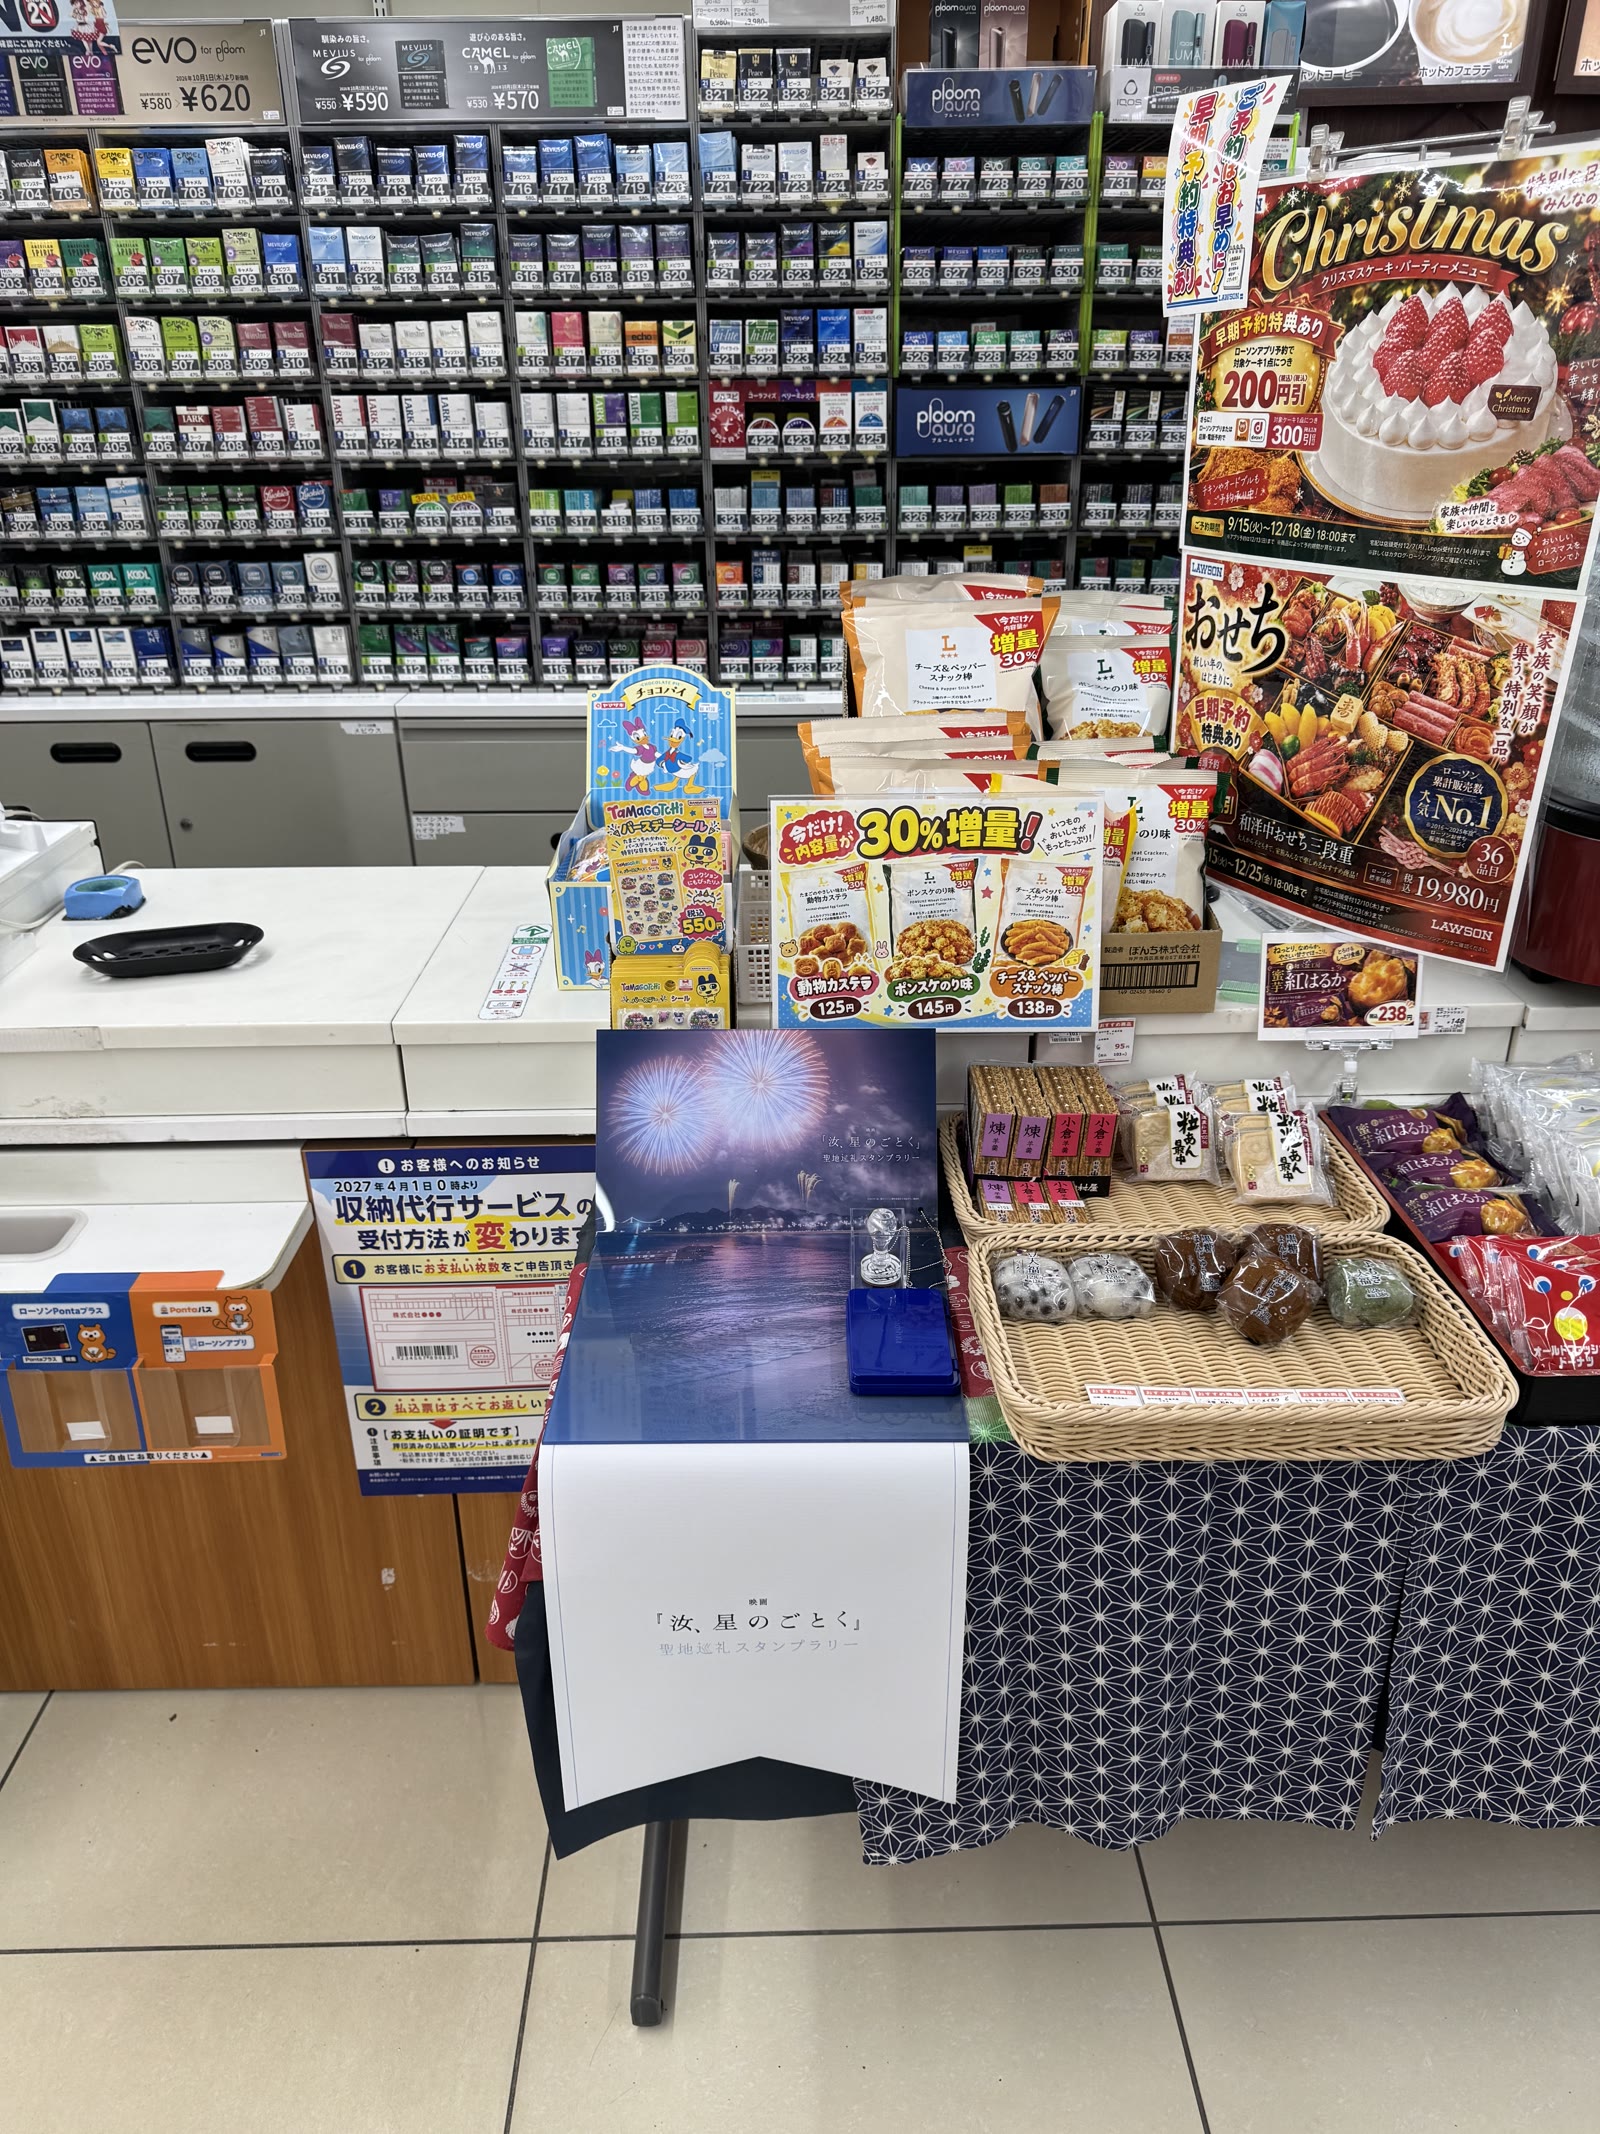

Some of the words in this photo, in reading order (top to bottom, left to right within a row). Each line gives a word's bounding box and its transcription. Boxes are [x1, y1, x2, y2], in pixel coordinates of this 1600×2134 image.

[132, 37, 197, 64] evo
[201, 46, 212, 54] for
[215, 40, 246, 62] ploom
[313, 49, 356, 58] MEVIUS
[462, 47, 511, 59] CAMEL
[20, 56, 48, 69] evo
[73, 55, 101, 68] evo
[1418, 65, 1491, 77] ホットカフェラテ
[140, 97, 172, 110] ¥580
[179, 83, 250, 112] ¥620
[315, 101, 337, 110] ¥550
[341, 92, 389, 111] ¥590
[467, 99, 488, 108] ¥530
[493, 91, 539, 110] ¥570
[743, 89, 768, 101] 822
[932, 78, 981, 113] ploom
[945, 100, 980, 112] aura
[1021, 177, 1047, 189] 729
[56, 188, 81, 200] 705
[344, 184, 368, 196] 712
[1262, 181, 1570, 291] Christmas
[431, 272, 454, 284] 614
[786, 268, 811, 280] 623
[979, 267, 1005, 278] 628
[1321, 260, 1490, 287] クリスマスケーキ・パーティーメニュー
[34, 278, 59, 288] 604
[232, 275, 256, 286] 609
[1215, 310, 1324, 348] 早期予約特典あり
[1046, 349, 1073, 361] 530
[1235, 346, 1295, 356] ローソンアプリ予約で
[88, 359, 112, 371] 505
[476, 357, 498, 368] 515
[1233, 357, 1293, 368] 対象ケーキ1点につき
[1508, 394, 1533, 405] Merry
[1492, 403, 1531, 414] Christmas
[182, 415, 205, 424] LARK
[916, 398, 976, 439] ploom
[932, 420, 975, 436] aura
[31, 442, 56, 453] 403
[410, 438, 432, 449] 413
[822, 435, 848, 447] 424
[1202, 473, 1260, 496] チキンやオードブルも
[1043, 509, 1066, 520] 330
[1440, 501, 1496, 518] 家族や仲間と
[47, 521, 71, 531] 303
[534, 516, 557, 527] 316
[1194, 520, 1221, 533] ご予約期間
[1446, 517, 1507, 530] 楽しいひとときを
[1542, 533, 1574, 545] おいしい
[1535, 542, 1581, 557] クリスマスを
[1191, 563, 1224, 577] LAWSON
[91, 571, 117, 583] KOOL
[130, 594, 153, 604] 205
[999, 614, 1029, 624] 今だけ
[1185, 582, 1288, 674] おせち
[992, 628, 1040, 653] 増量
[1002, 651, 1038, 666] 30%
[1192, 656, 1226, 672] 新しい年の、
[218, 666, 241, 676] 107
[434, 664, 455, 674] 113
[915, 662, 987, 673] チーズ&ペッパー
[1134, 659, 1168, 673] 増量
[929, 672, 973, 682] スナック棒
[1142, 672, 1167, 682] 30%
[1201, 672, 1235, 688] はじまりに。
[1519, 631, 1556, 734] 家族の笑顔が
[635, 685, 687, 699] チョコパイ
[1491, 642, 1530, 764] 集う、特別な一品。
[1194, 697, 1251, 733] 早期予約
[1201, 723, 1242, 750] 特典あり
[1443, 767, 1480, 780] ローソン
[1432, 776, 1484, 795] 累計販売数
[1169, 801, 1210, 819] 増量
[1431, 793, 1493, 830] No.1
[621, 818, 709, 834] バースデーシール
[790, 813, 843, 845] 今だけ!
[1051, 816, 1081, 830] いつもの
[1176, 819, 1206, 832] 30%
[1050, 823, 1086, 841] おいしさが
[1046, 833, 1092, 851] もっとたっぷり!
[1239, 812, 1356, 867] 和洋中おせち三段重
[795, 831, 855, 862] 内容量が
[1480, 843, 1504, 864] 36
[688, 871, 719, 881] コレクション
[1371, 867, 1393, 879] ローソン
[1475, 862, 1500, 878] 品目
[1369, 873, 1393, 886] 標準価格
[806, 893, 848, 904] 動物カステラ
[907, 887, 956, 897] ポンスケのり味
[1415, 875, 1500, 913] 19,980円
[687, 909, 705, 917] 税込
[681, 917, 724, 934] 550円
[1430, 919, 1494, 942] LAWSON
[1129, 944, 1200, 955] ぼんち株式会社
[997, 972, 1077, 985] チーズ&ペッパー
[1270, 970, 1285, 993] 蜜芋
[1285, 973, 1347, 991] 紅はるか
[796, 975, 872, 997] 動物カステラ
[894, 976, 973, 997] ポンスケのり味
[1011, 983, 1062, 996] スナック棒
[670, 994, 690, 1003] シール
[818, 1001, 854, 1016] 125円
[916, 1001, 954, 1016] 145円
[1017, 1001, 1054, 1015] 138円
[1379, 1005, 1413, 1021] 238円
[1060, 1116, 1076, 1139] 小倉
[1094, 1116, 1109, 1140] 小倉
[1375, 1120, 1433, 1145] 紅はるか
[820, 1134, 922, 1151] 「汝、星のごとく」
[400, 1156, 540, 1172] お客様へのお知らせ
[822, 1152, 921, 1163] 聖地巡礼スタンプラリー
[1396, 1156, 1457, 1175] 紅はるか
[336, 1191, 594, 1225] 収納代行サービスの
[1425, 1193, 1488, 1218] 紅はるか
[19, 1307, 103, 1316] ローソンPontaプラス
[170, 1305, 212, 1314] Pontaパス
[198, 1339, 248, 1347] ローソンアプリ
[99, 1452, 200, 1461] ご自由にお取りください
[748, 1597, 768, 1606] 映画
[655, 1610, 862, 1634] 『汝、星のごとく』
[659, 1638, 860, 1656] 聖地巡礼スタンプラリー
